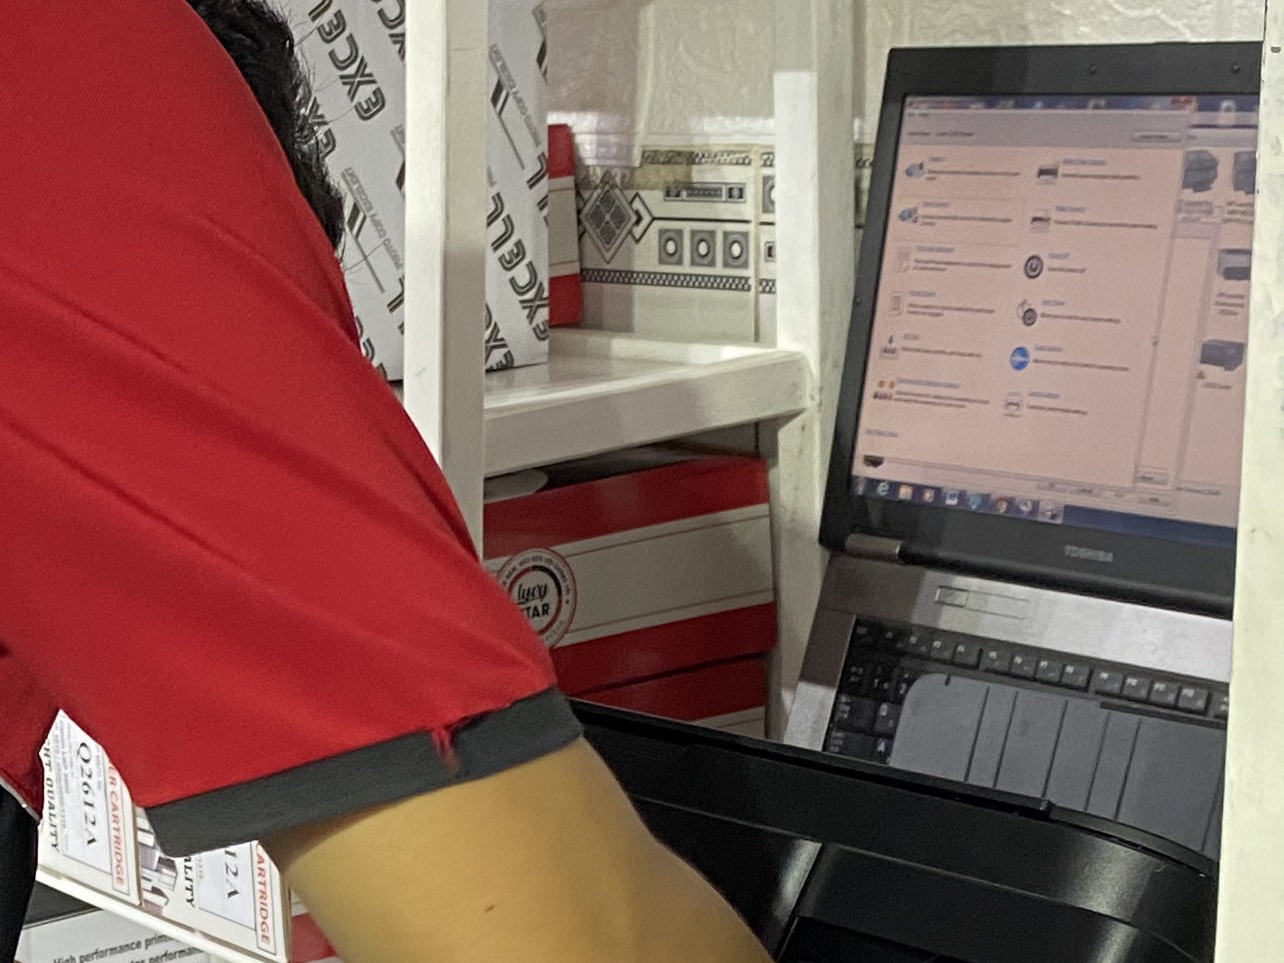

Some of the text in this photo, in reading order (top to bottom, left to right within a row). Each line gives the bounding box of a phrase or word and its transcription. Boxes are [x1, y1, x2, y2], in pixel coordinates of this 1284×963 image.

[521, 603, 550, 619] TAR
[46, 777, 60, 853] QUALITY
[77, 742, 97, 846] Q2612A
[110, 790, 125, 887] CARTRIDGE
[224, 850, 239, 899] 12A
